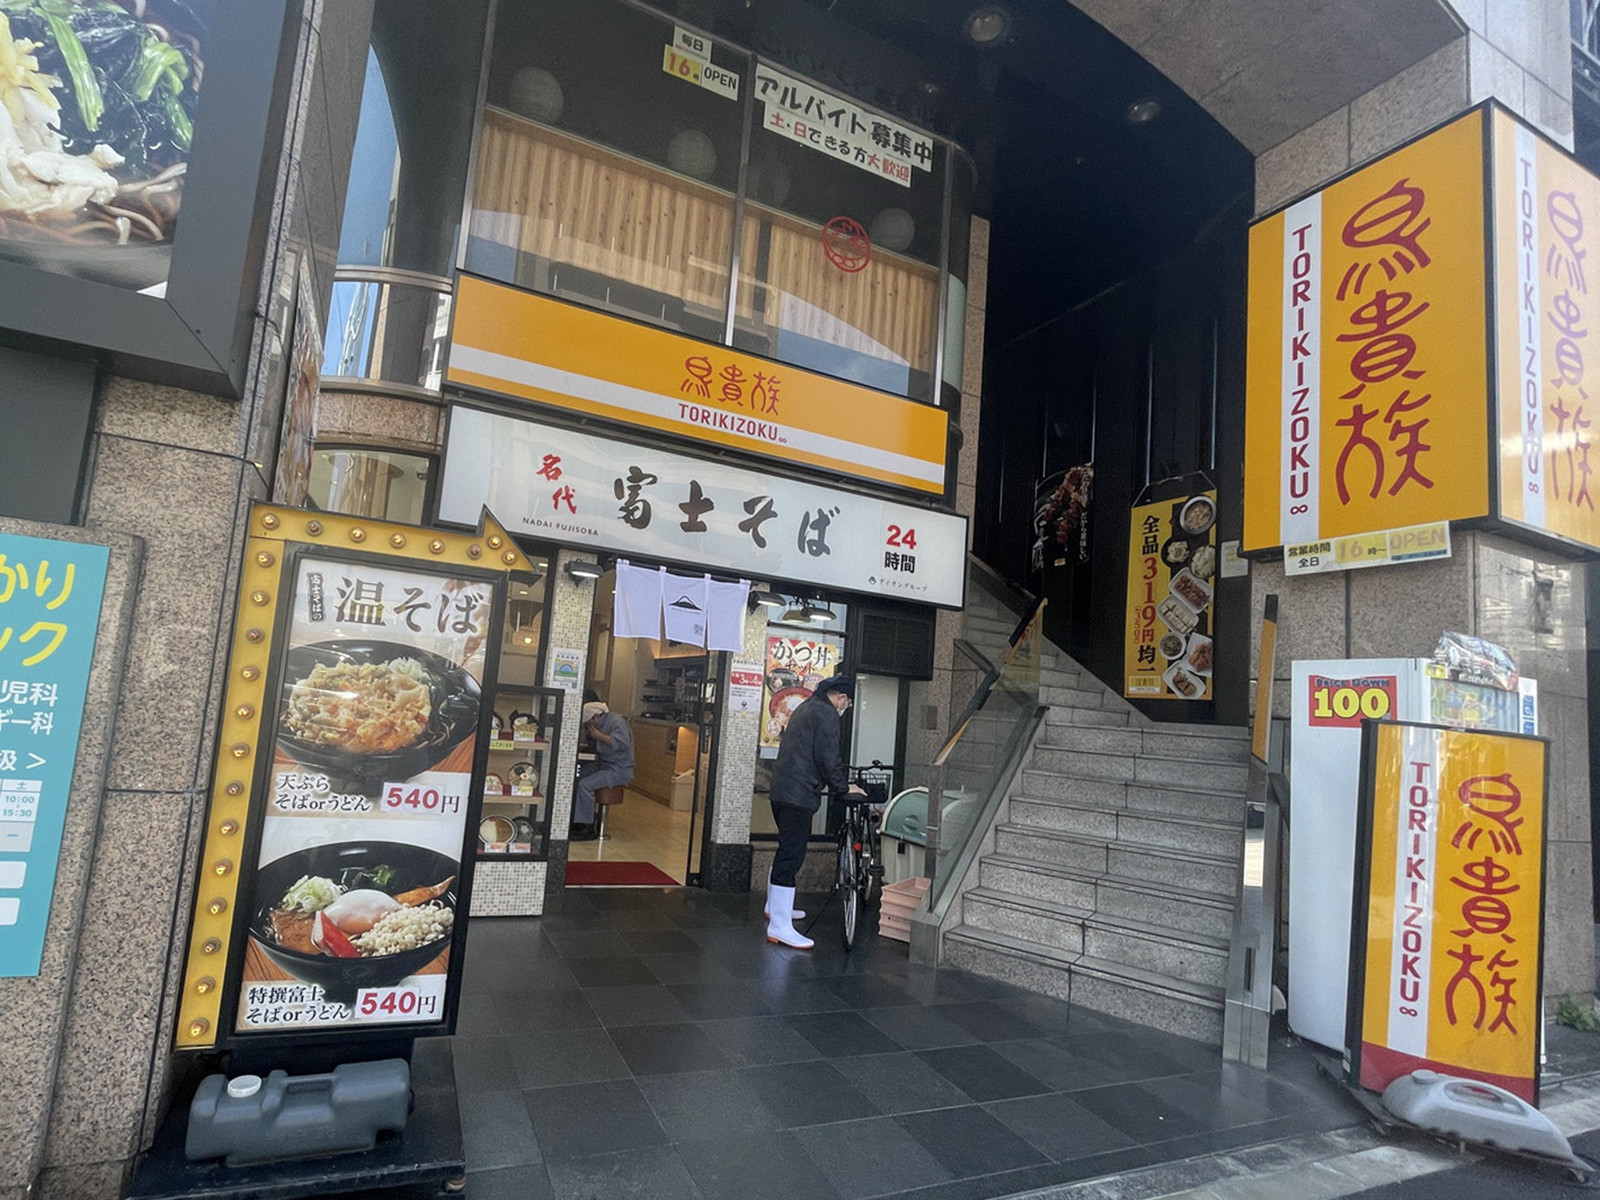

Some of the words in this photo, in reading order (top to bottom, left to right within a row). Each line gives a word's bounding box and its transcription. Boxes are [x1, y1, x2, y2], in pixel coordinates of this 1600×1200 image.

[682, 33, 704, 52] 毎日
[704, 66, 737, 90] OPEN
[757, 75, 931, 164] アルバイト募集中
[770, 112, 910, 182] 土・日できる方大歓迎
[1290, 223, 1313, 499] TORIKIZOKU
[678, 402, 778, 441] TORIKIZOKU
[536, 453, 578, 515] 名代
[613, 465, 841, 558] 富士そば
[522, 517, 552, 529] NADAI
[555, 523, 599, 537] FUJISOBA
[885, 524, 917, 550] 24
[1389, 526, 1446, 551] OPEN
[1288, 541, 1331, 558] 営業時間
[884, 551, 917, 574] 時間
[1298, 556, 1320, 569] 全日
[333, 575, 485, 635] 温そば
[1136, 514, 1161, 672] 全品319円均一
[772, 640, 831, 668] かつ丼
[1352, 678, 1390, 688] DOWN
[1313, 686, 1391, 719] 100
[278, 773, 330, 792] 天ぷら
[5, 795, 35, 804] 10:00
[275, 793, 370, 812] そばorうどん
[3, 808, 32, 817] 15:30
[1399, 761, 1430, 1003] TORIKIZOKU
[249, 985, 325, 1006] 特撰富士
[246, 1003, 350, 1024] そばorうどん
